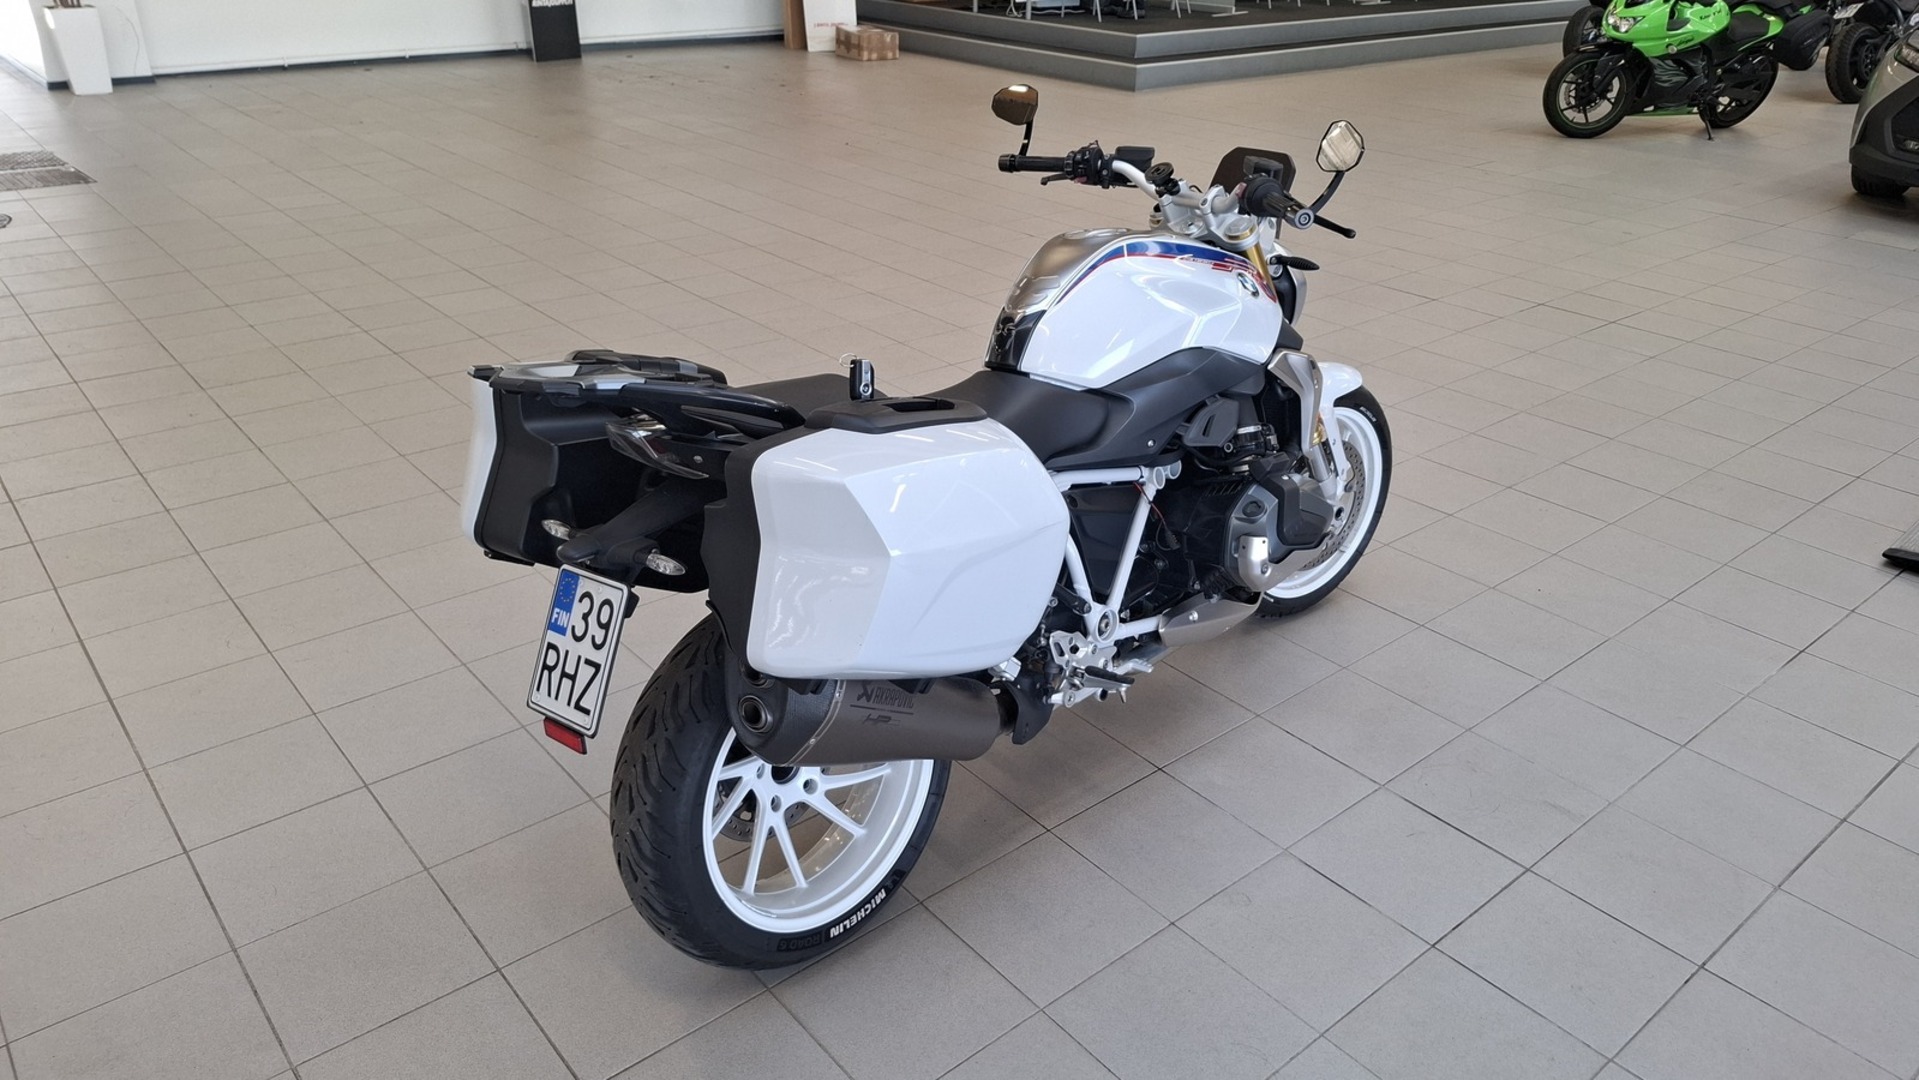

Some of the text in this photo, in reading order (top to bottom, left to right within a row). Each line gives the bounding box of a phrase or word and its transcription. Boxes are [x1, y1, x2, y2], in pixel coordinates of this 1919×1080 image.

[551, 607, 570, 628] FIN
[571, 591, 614, 650] 39
[536, 641, 602, 716] RHZ
[829, 888, 887, 939] MICHELIN
[790, 934, 820, 949] ROAD
